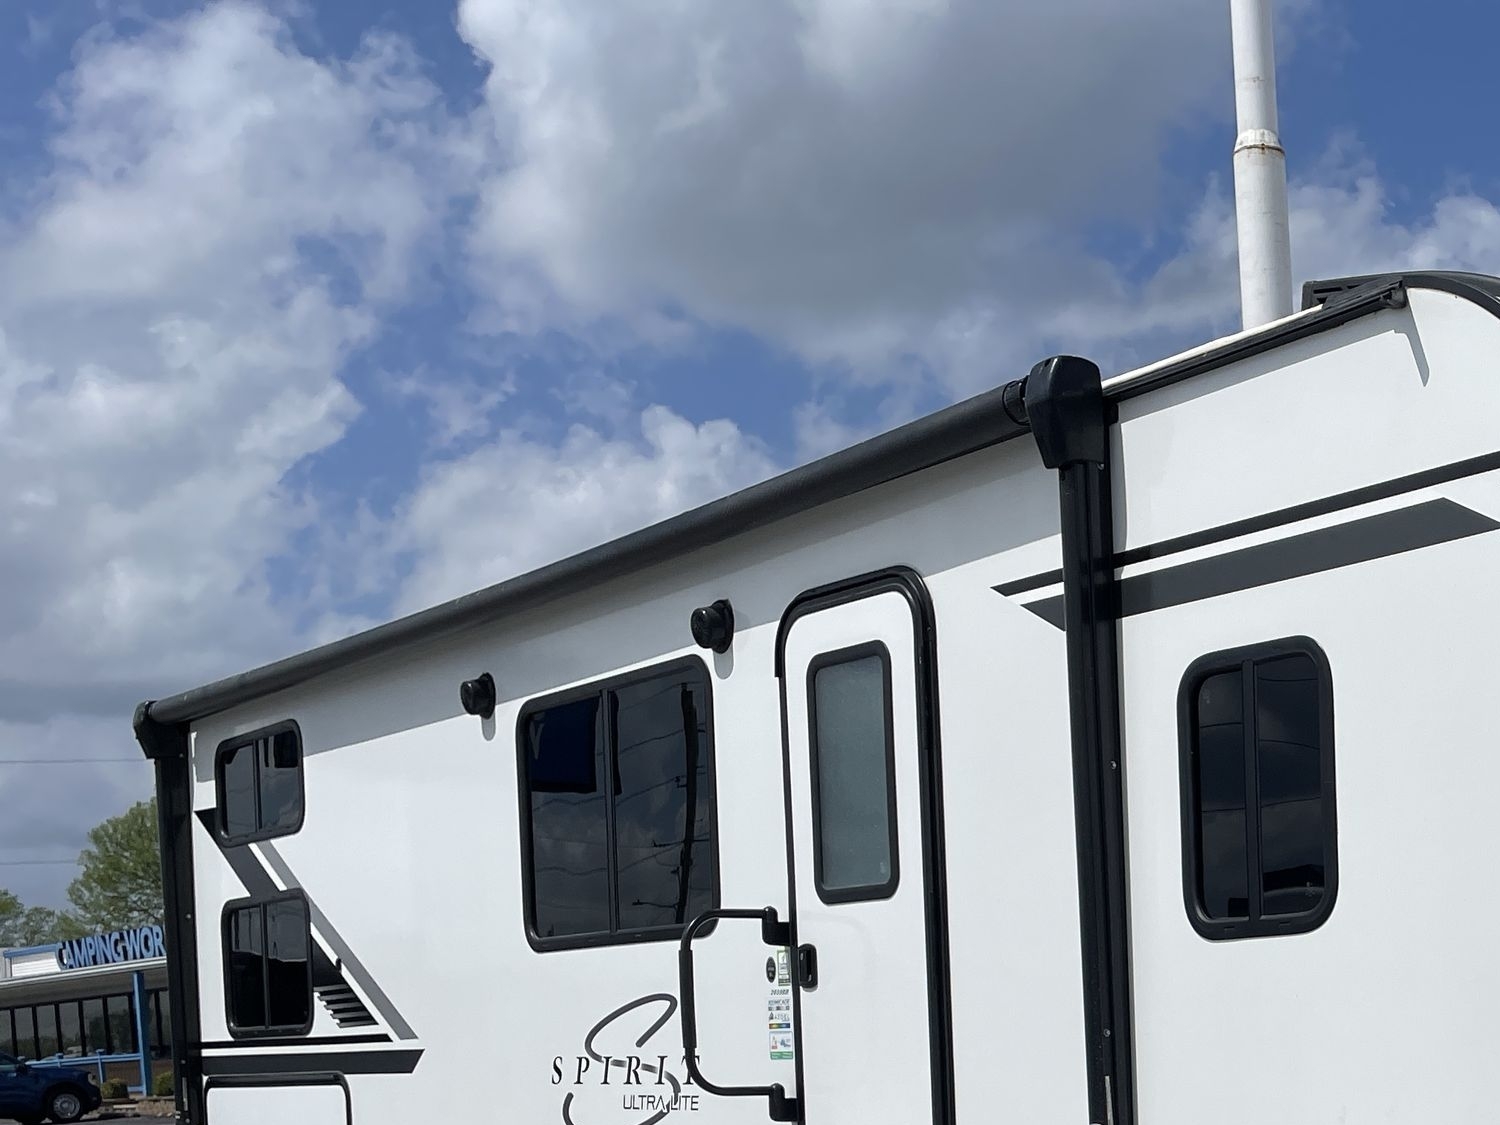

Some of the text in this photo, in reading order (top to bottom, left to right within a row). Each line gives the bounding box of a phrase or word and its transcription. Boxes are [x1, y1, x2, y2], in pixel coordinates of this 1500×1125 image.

[55, 931, 123, 971] CAMPING
[551, 1055, 700, 1085] SPIRIT
[623, 1095, 700, 1111] ULTRA LITE
